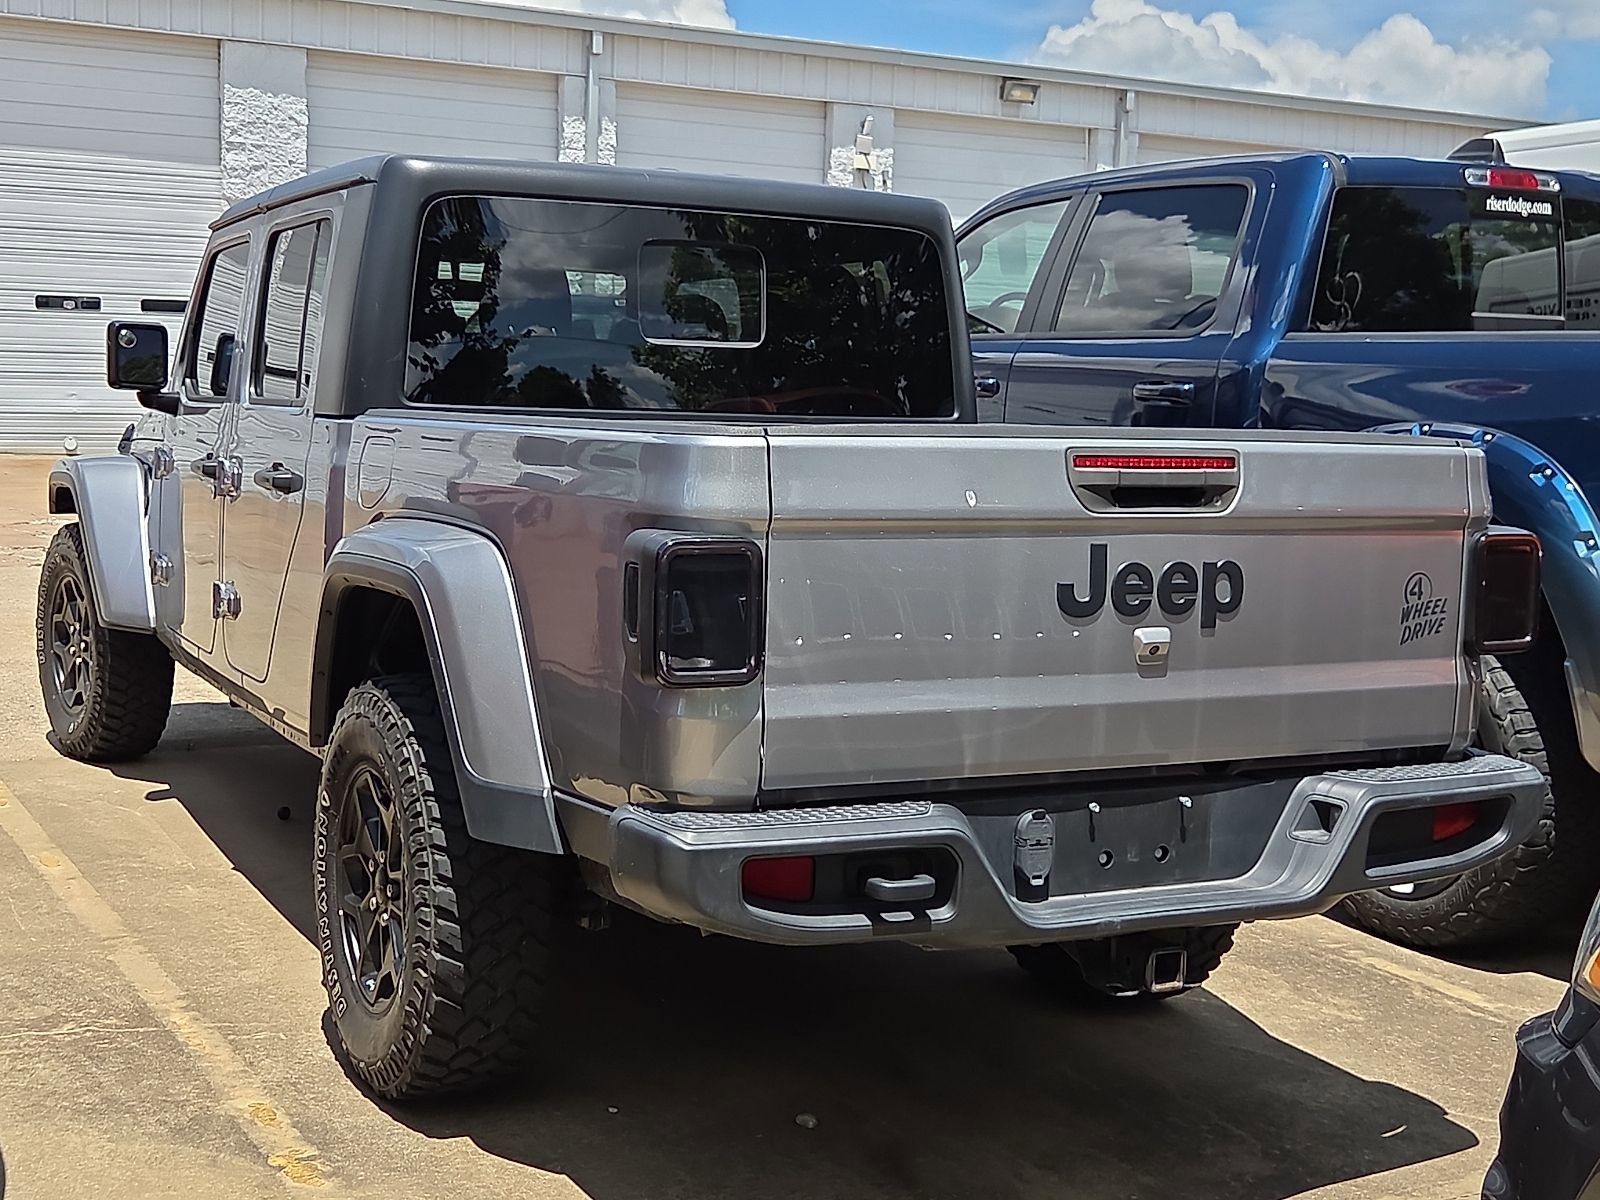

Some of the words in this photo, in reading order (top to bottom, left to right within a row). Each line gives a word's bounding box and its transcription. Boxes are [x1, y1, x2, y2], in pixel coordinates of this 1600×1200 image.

[1486, 196, 1552, 217] riserdodge.com
[1056, 543, 1245, 629] Jeep
[1409, 576, 1424, 601] 4
[1400, 598, 1448, 625] WHEEL
[1400, 617, 1446, 646] DRIVE
[316, 812, 349, 1018] DESTINATION
